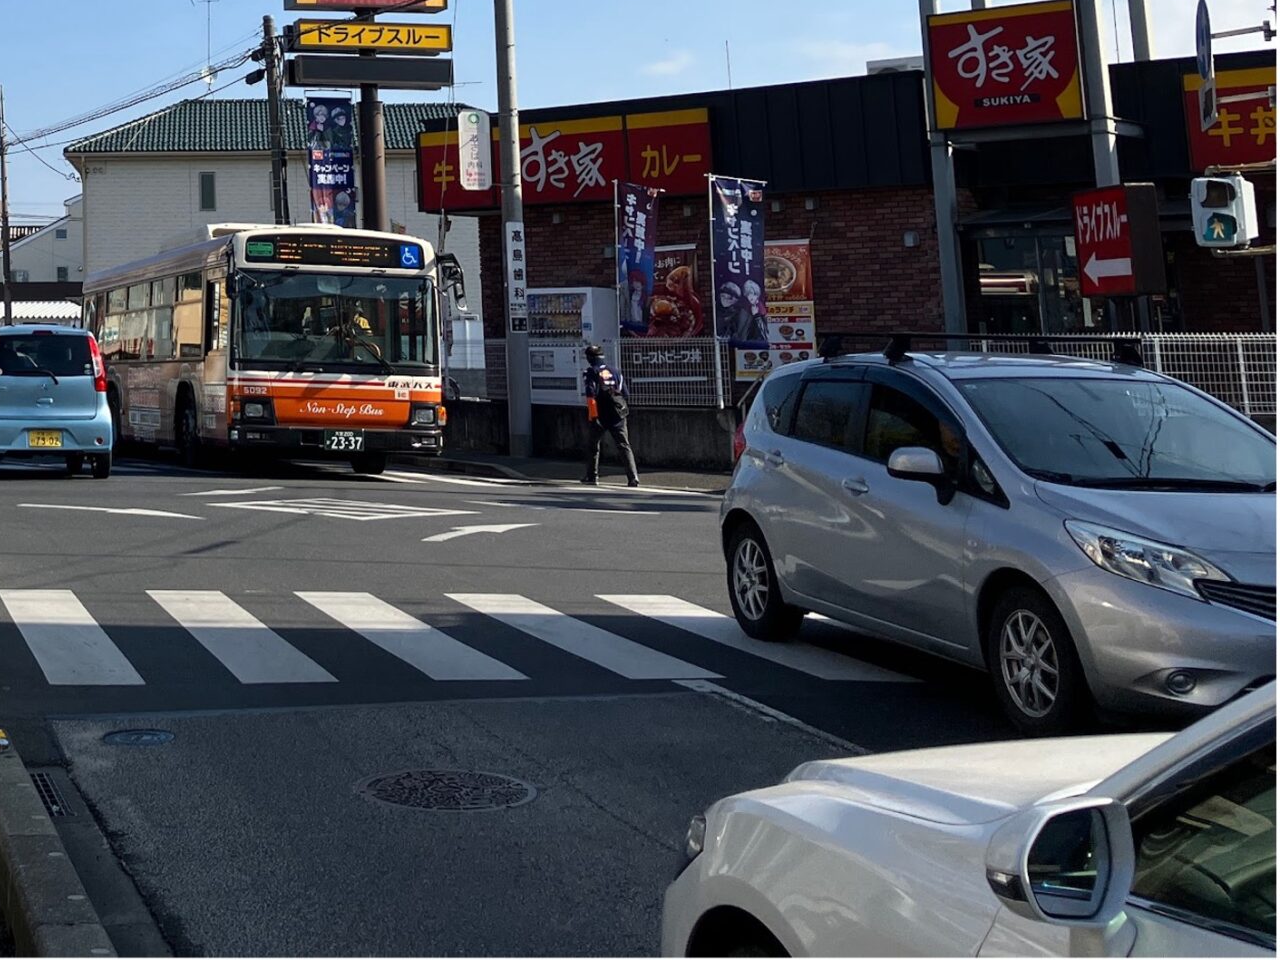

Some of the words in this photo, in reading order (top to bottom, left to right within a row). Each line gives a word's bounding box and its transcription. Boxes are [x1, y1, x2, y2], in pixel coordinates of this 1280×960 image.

[316, 26, 441, 46] ドライブスルー
[948, 24, 1060, 91] すき家
[982, 94, 1032, 107] SUKIYA
[313, 163, 350, 173] キャンペーン
[520, 125, 607, 198] すき家
[640, 143, 702, 178] カレー
[1076, 200, 1128, 244] ドライブスルー
[243, 386, 267, 395] 5092
[299, 401, 356, 419] Non-Step
[358, 403, 385, 417] Bus
